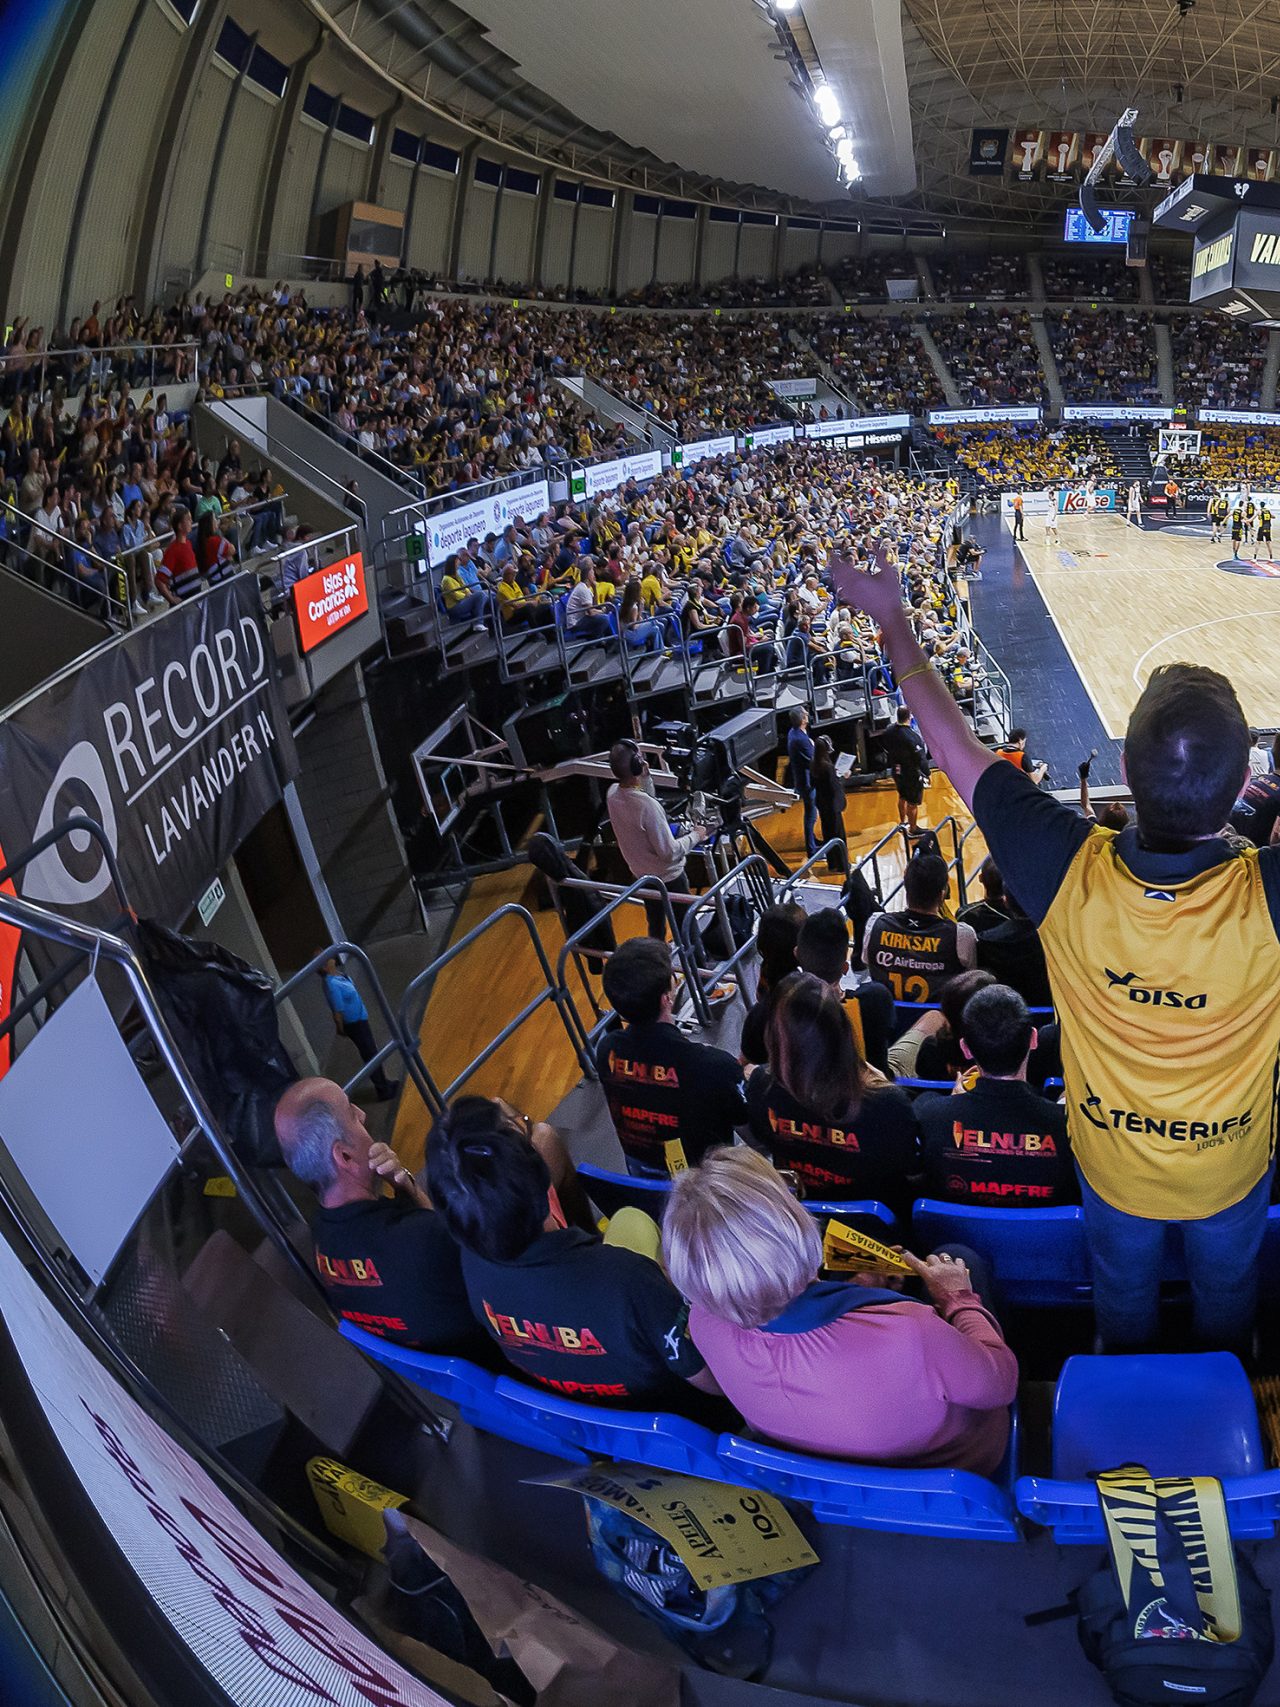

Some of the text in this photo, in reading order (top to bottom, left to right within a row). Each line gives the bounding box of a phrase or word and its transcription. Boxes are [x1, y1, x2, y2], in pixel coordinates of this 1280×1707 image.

[865, 433, 902, 445] Hisense
[440, 519, 487, 551] deporte lagunero
[322, 572, 344, 595] Islas
[308, 588, 346, 622] Canarias
[103, 616, 265, 794] RECORD
[880, 930, 942, 953] KIRKSAY
[888, 972, 930, 1004] 12
[1109, 1108, 1253, 1142] TENERIFE
[1196, 1135, 1225, 1153] 100%
[970, 1180, 1055, 1198] MAPFRE
[662, 1500, 725, 1559] APELES
[739, 1496, 781, 1541] IOC
